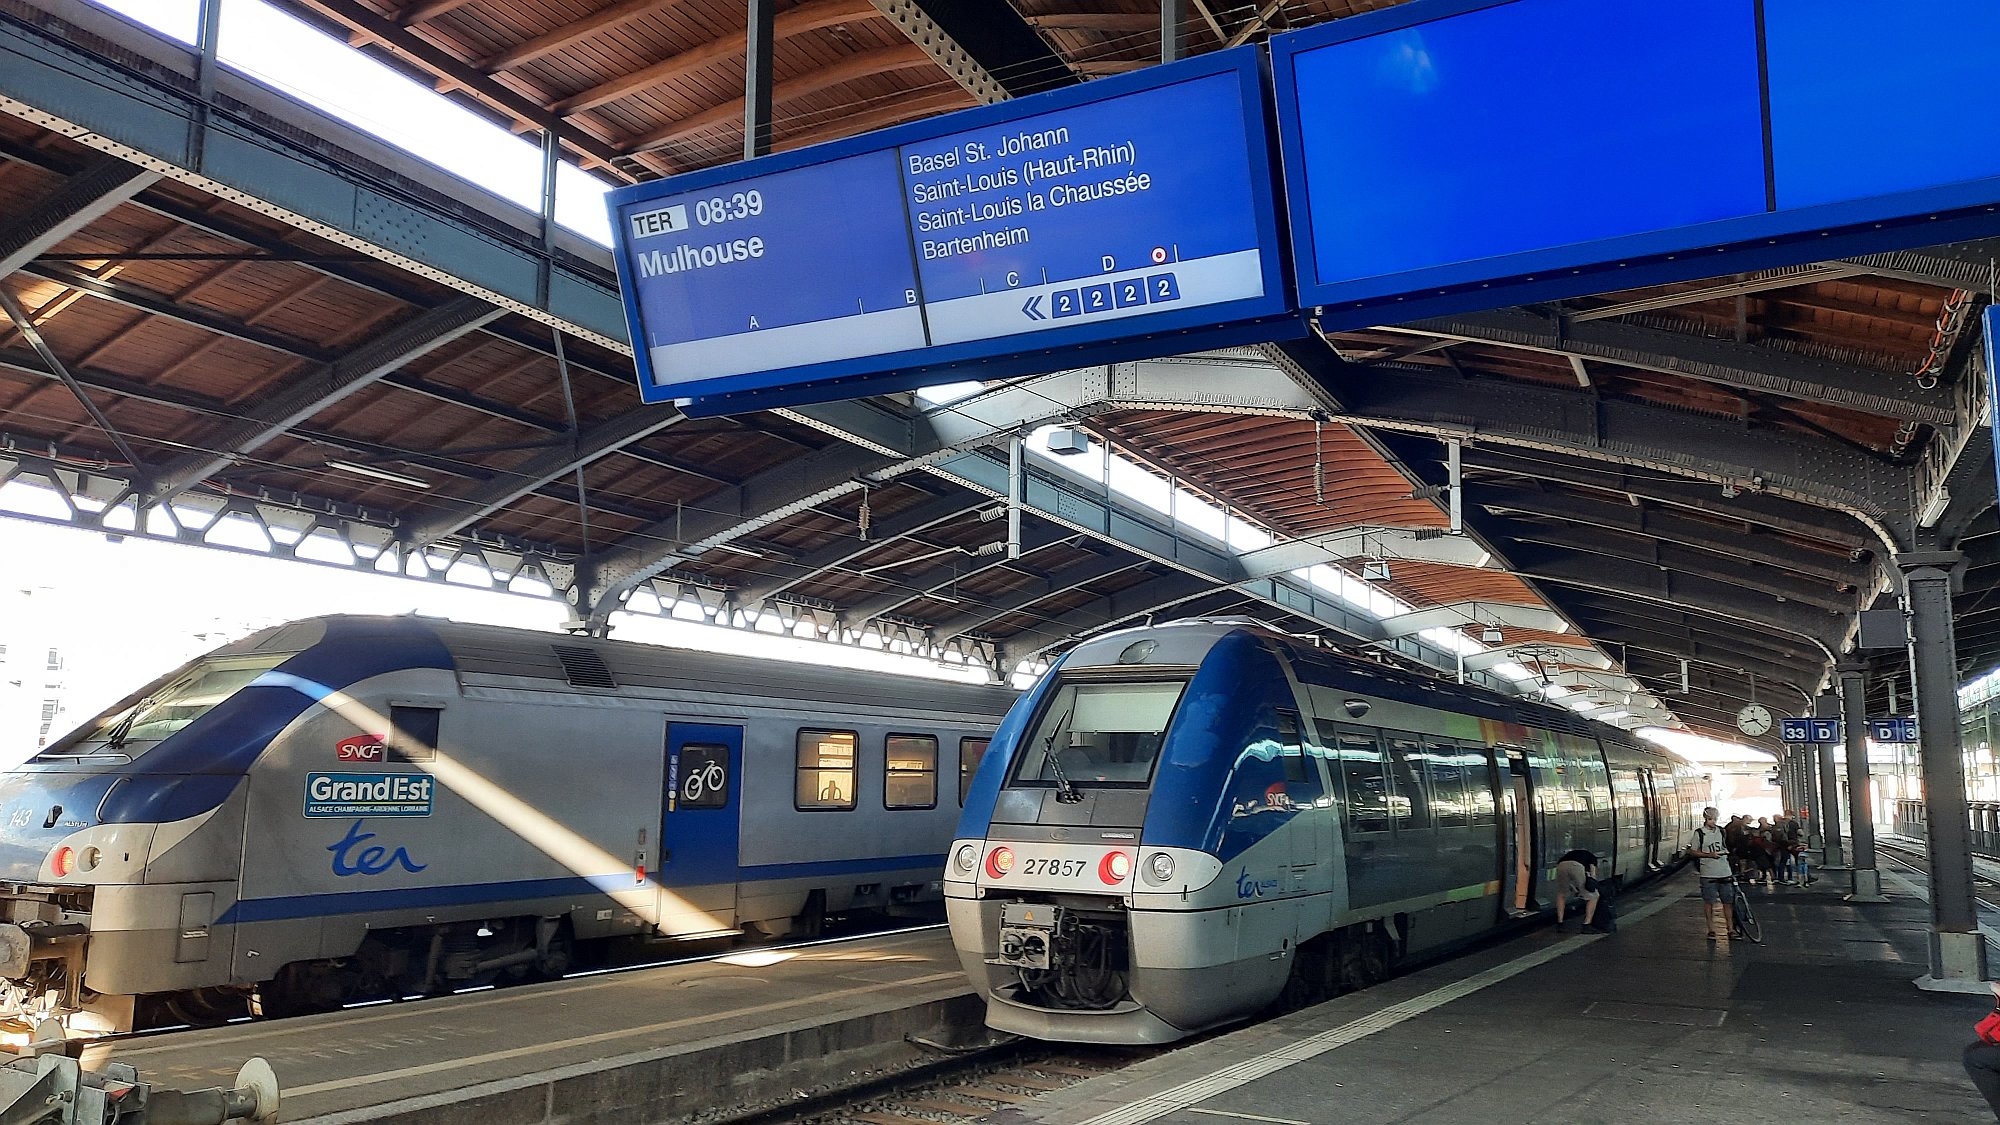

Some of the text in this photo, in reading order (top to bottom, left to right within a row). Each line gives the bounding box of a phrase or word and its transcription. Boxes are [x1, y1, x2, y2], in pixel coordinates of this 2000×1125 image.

[909, 127, 1069, 174] Basel St. Johann
[913, 141, 1136, 203] Saint-Louis (Haut-Rhin)
[633, 189, 763, 235] TER 08:39
[918, 171, 1151, 232] Saint-Louis la Chaussée
[638, 236, 764, 278] Mulhouse
[922, 226, 1029, 260] Bartenheim
[749, 255, 1115, 329] A B C D
[1059, 280, 1170, 312] 2 2 2 2
[1786, 727, 1831, 739] 33 D
[1879, 728, 1916, 739] D 3
[339, 744, 382, 759] SNCF
[9, 808, 33, 827] 143
[309, 805, 333, 813] ALSACE
[325, 818, 428, 876] ter
[1023, 858, 1087, 878] 27857
[1236, 865, 1264, 898] ter
